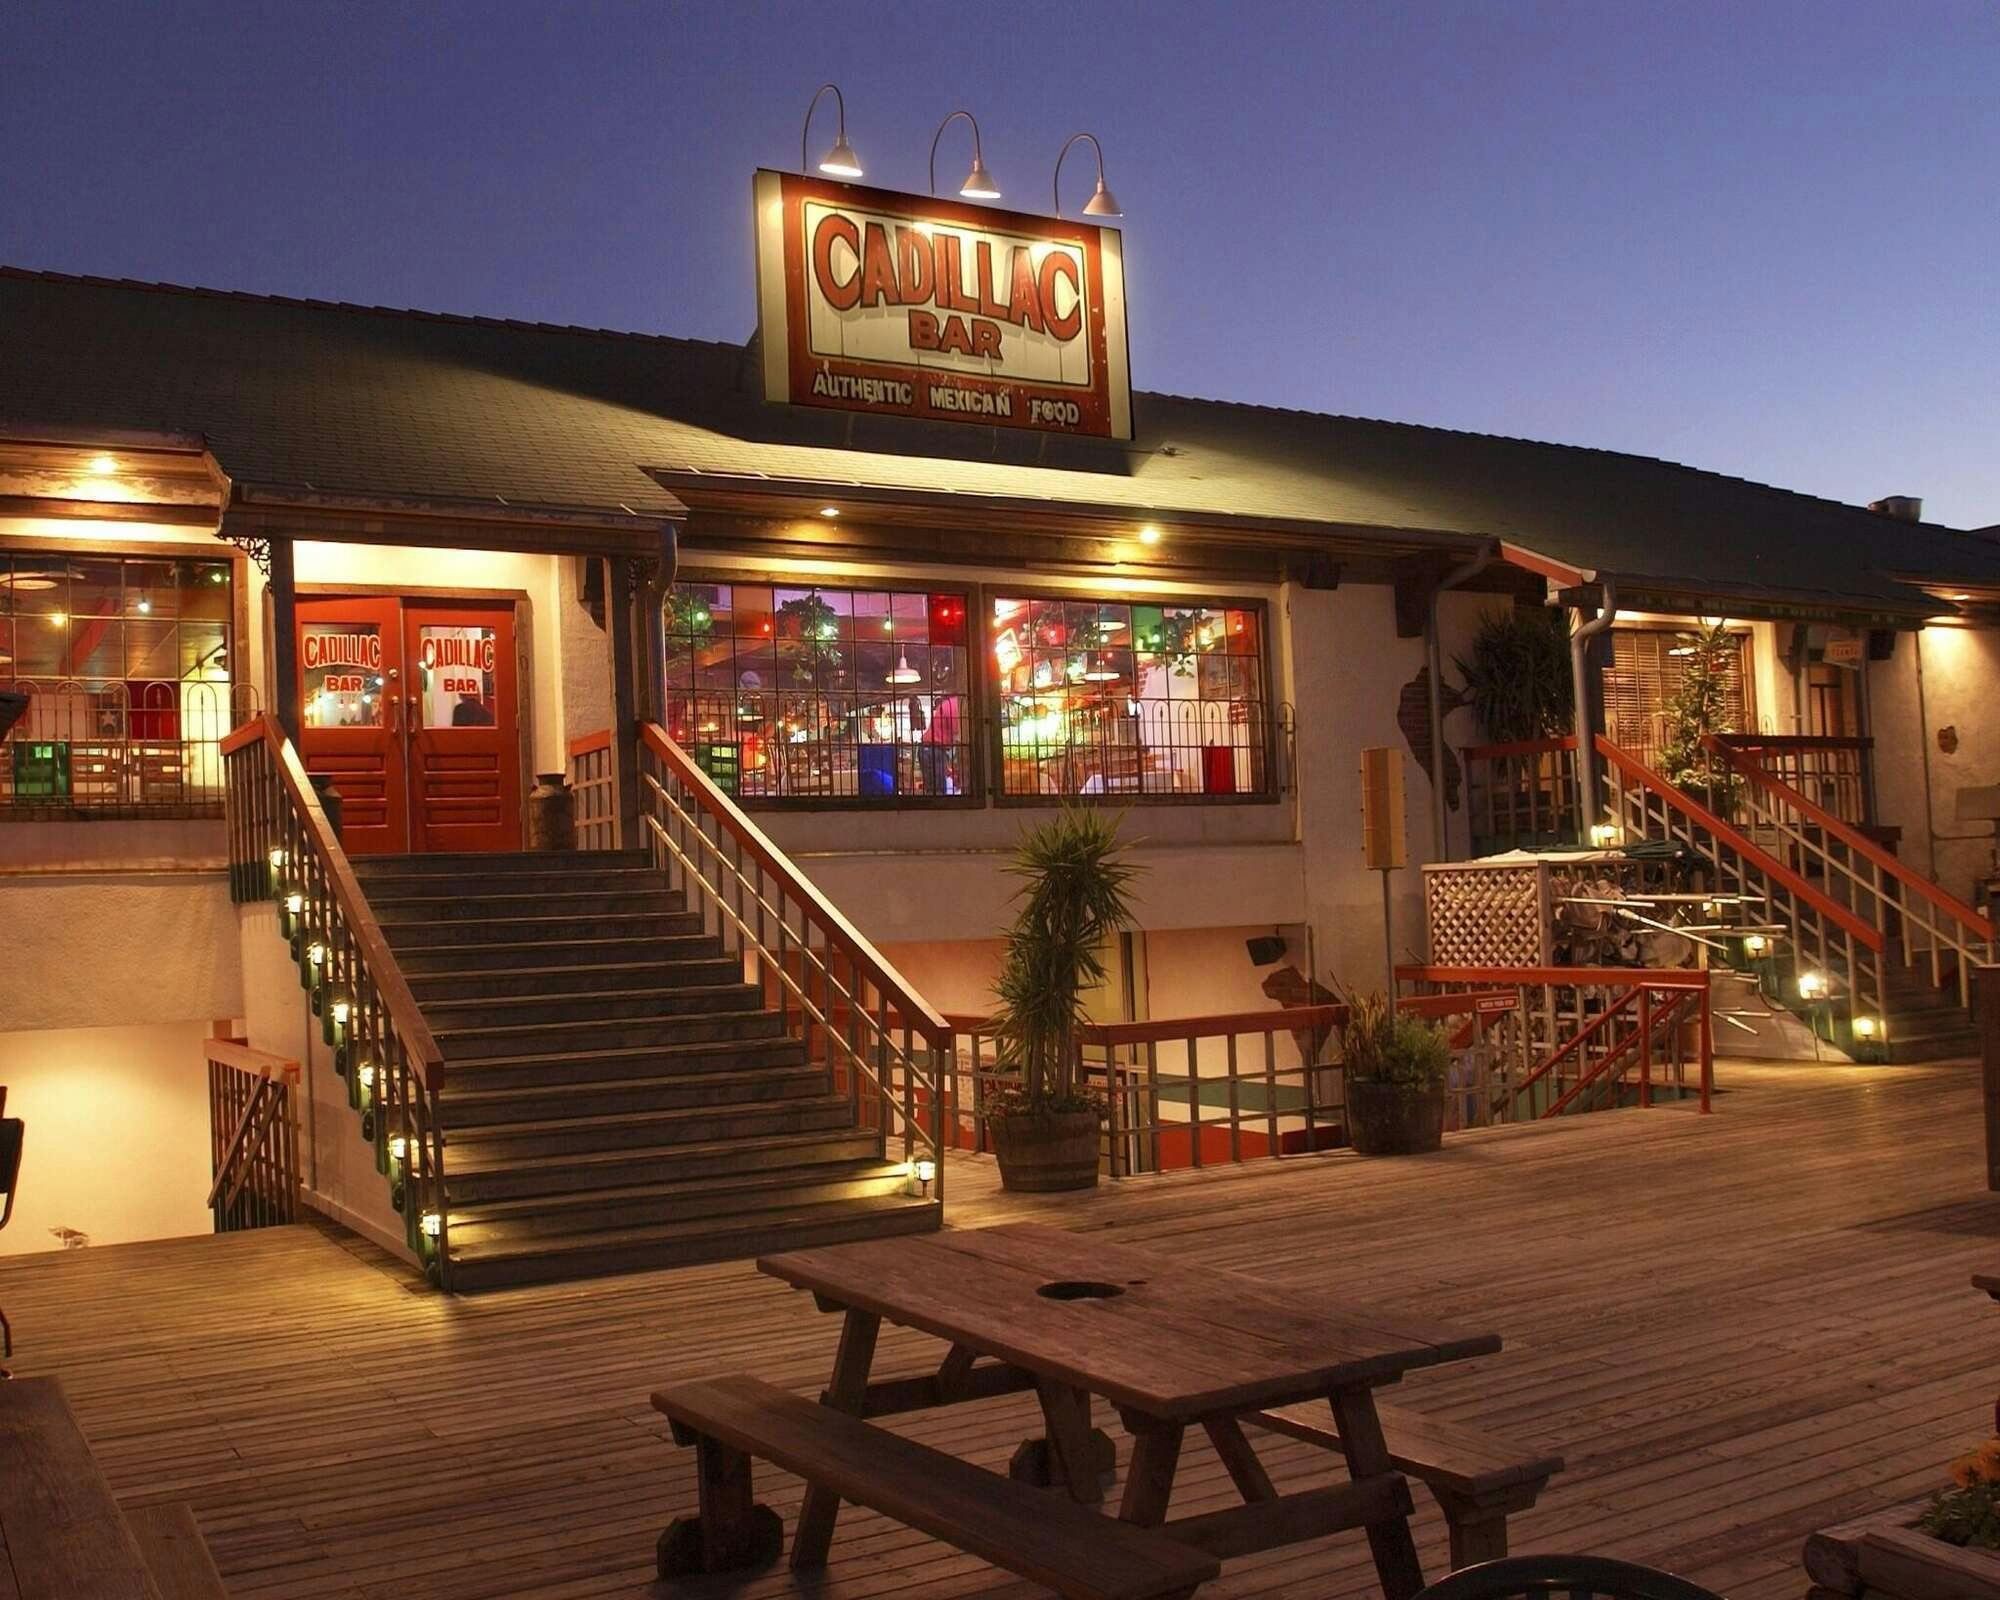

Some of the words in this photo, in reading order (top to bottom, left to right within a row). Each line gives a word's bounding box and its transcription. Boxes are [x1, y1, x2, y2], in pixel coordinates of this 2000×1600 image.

[813, 213, 1082, 341] CADILLAC
[908, 309, 1003, 361] BAR
[812, 373, 913, 405] AUTHENTIC
[929, 386, 1012, 417] MEXICAN
[1030, 399, 1080, 425] FOOD
[303, 634, 380, 669] CADILLAC
[421, 637, 494, 672] CADILLAC
[325, 675, 363, 692] BAR
[443, 678, 478, 694] BAR
